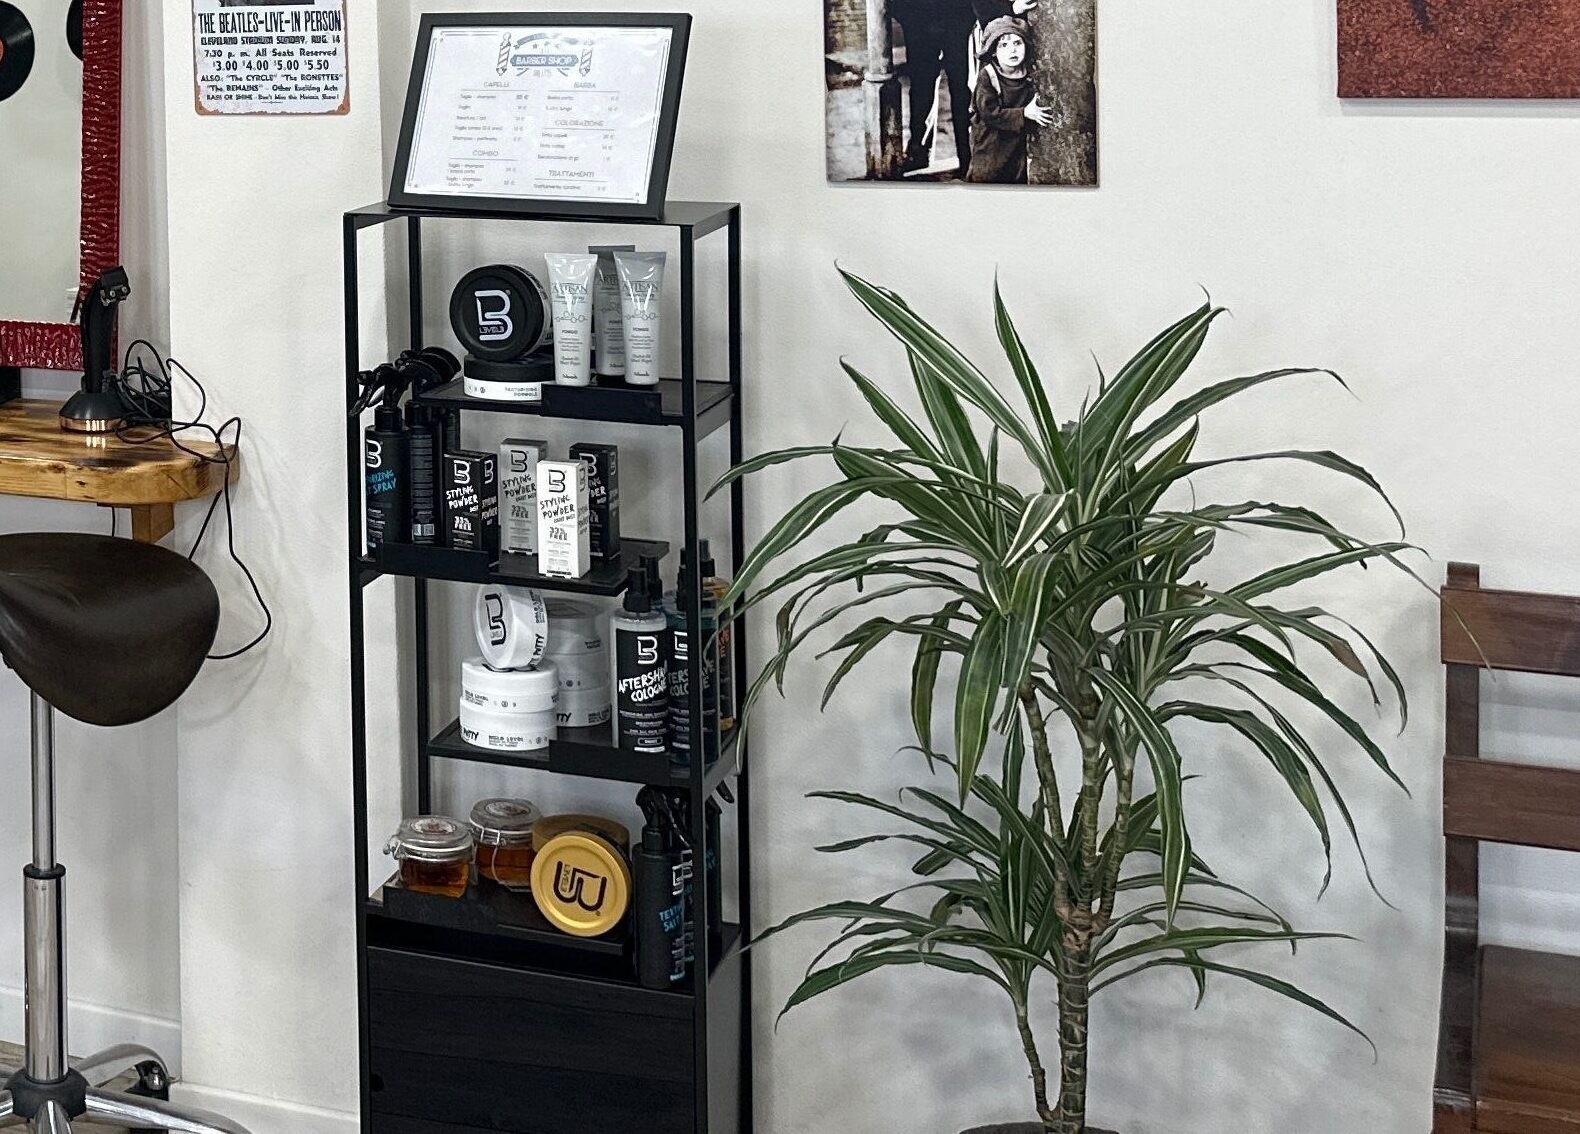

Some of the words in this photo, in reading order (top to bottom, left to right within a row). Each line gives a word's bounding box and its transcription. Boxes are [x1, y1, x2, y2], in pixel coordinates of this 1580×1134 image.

[198, 12, 216, 34] THE
[304, 9, 341, 32] PERSON
[332, 34, 341, 44] 14
[255, 48, 267, 57] All
[272, 48, 295, 57] Seats
[299, 47, 338, 57] Reserved
[515, 56, 547, 66] BARBER
[548, 56, 573, 66] SHOP
[373, 477, 397, 494] SPRAY
[503, 473, 532, 490] STYLING
[446, 485, 474, 500] STYLING
[504, 482, 537, 499] POWDER
[448, 493, 479, 509] POWDER
[540, 494, 571, 510] STYLING
[542, 503, 575, 519] POWDER
